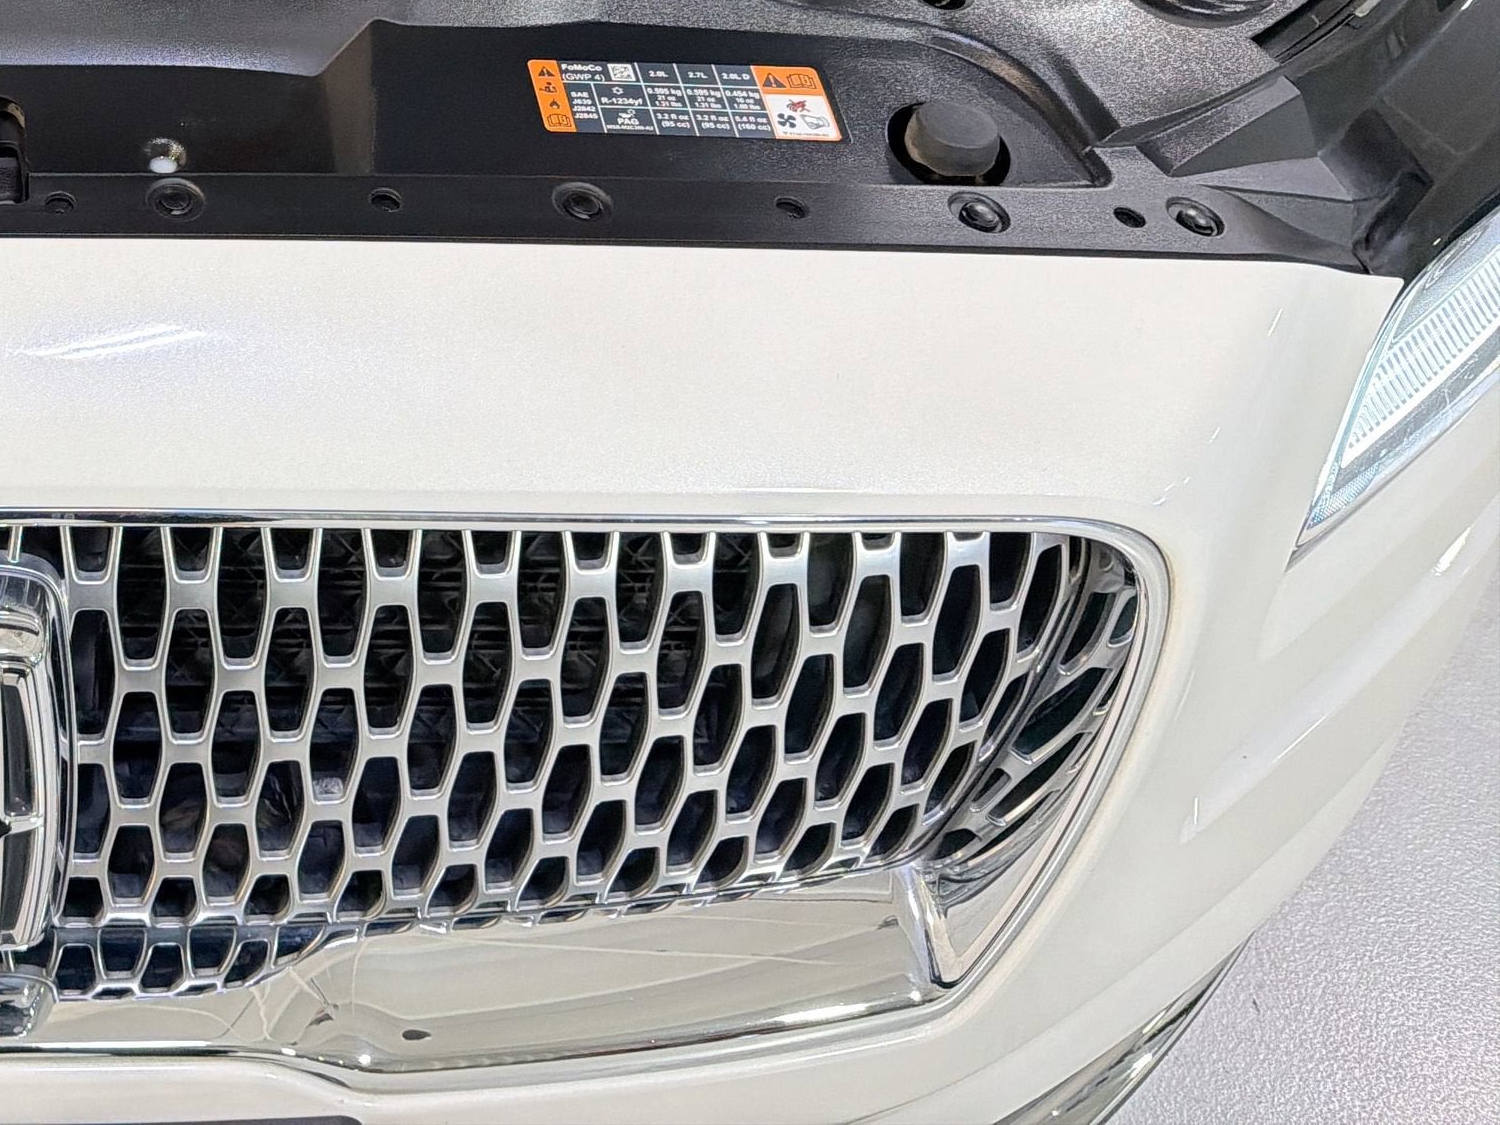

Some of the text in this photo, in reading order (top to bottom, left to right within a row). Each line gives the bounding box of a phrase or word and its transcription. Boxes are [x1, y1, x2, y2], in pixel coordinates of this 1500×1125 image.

[561, 63, 603, 72] FoMoCo
[562, 72, 605, 82] (GWP 4)
[648, 70, 669, 78] 2.0L
[687, 71, 709, 79] 2.7L
[721, 72, 750, 81] 2.0L D
[647, 87, 682, 97] 0.595 kg
[686, 88, 722, 98] 0.595 kg
[725, 89, 760, 99] 0.454 kg
[600, 97, 643, 106] R-1234yf
[616, 117, 640, 126] PAG
[661, 120, 691, 129] (95 cc)
[701, 122, 715, 130] (95
[757, 124, 772, 132] cc)
